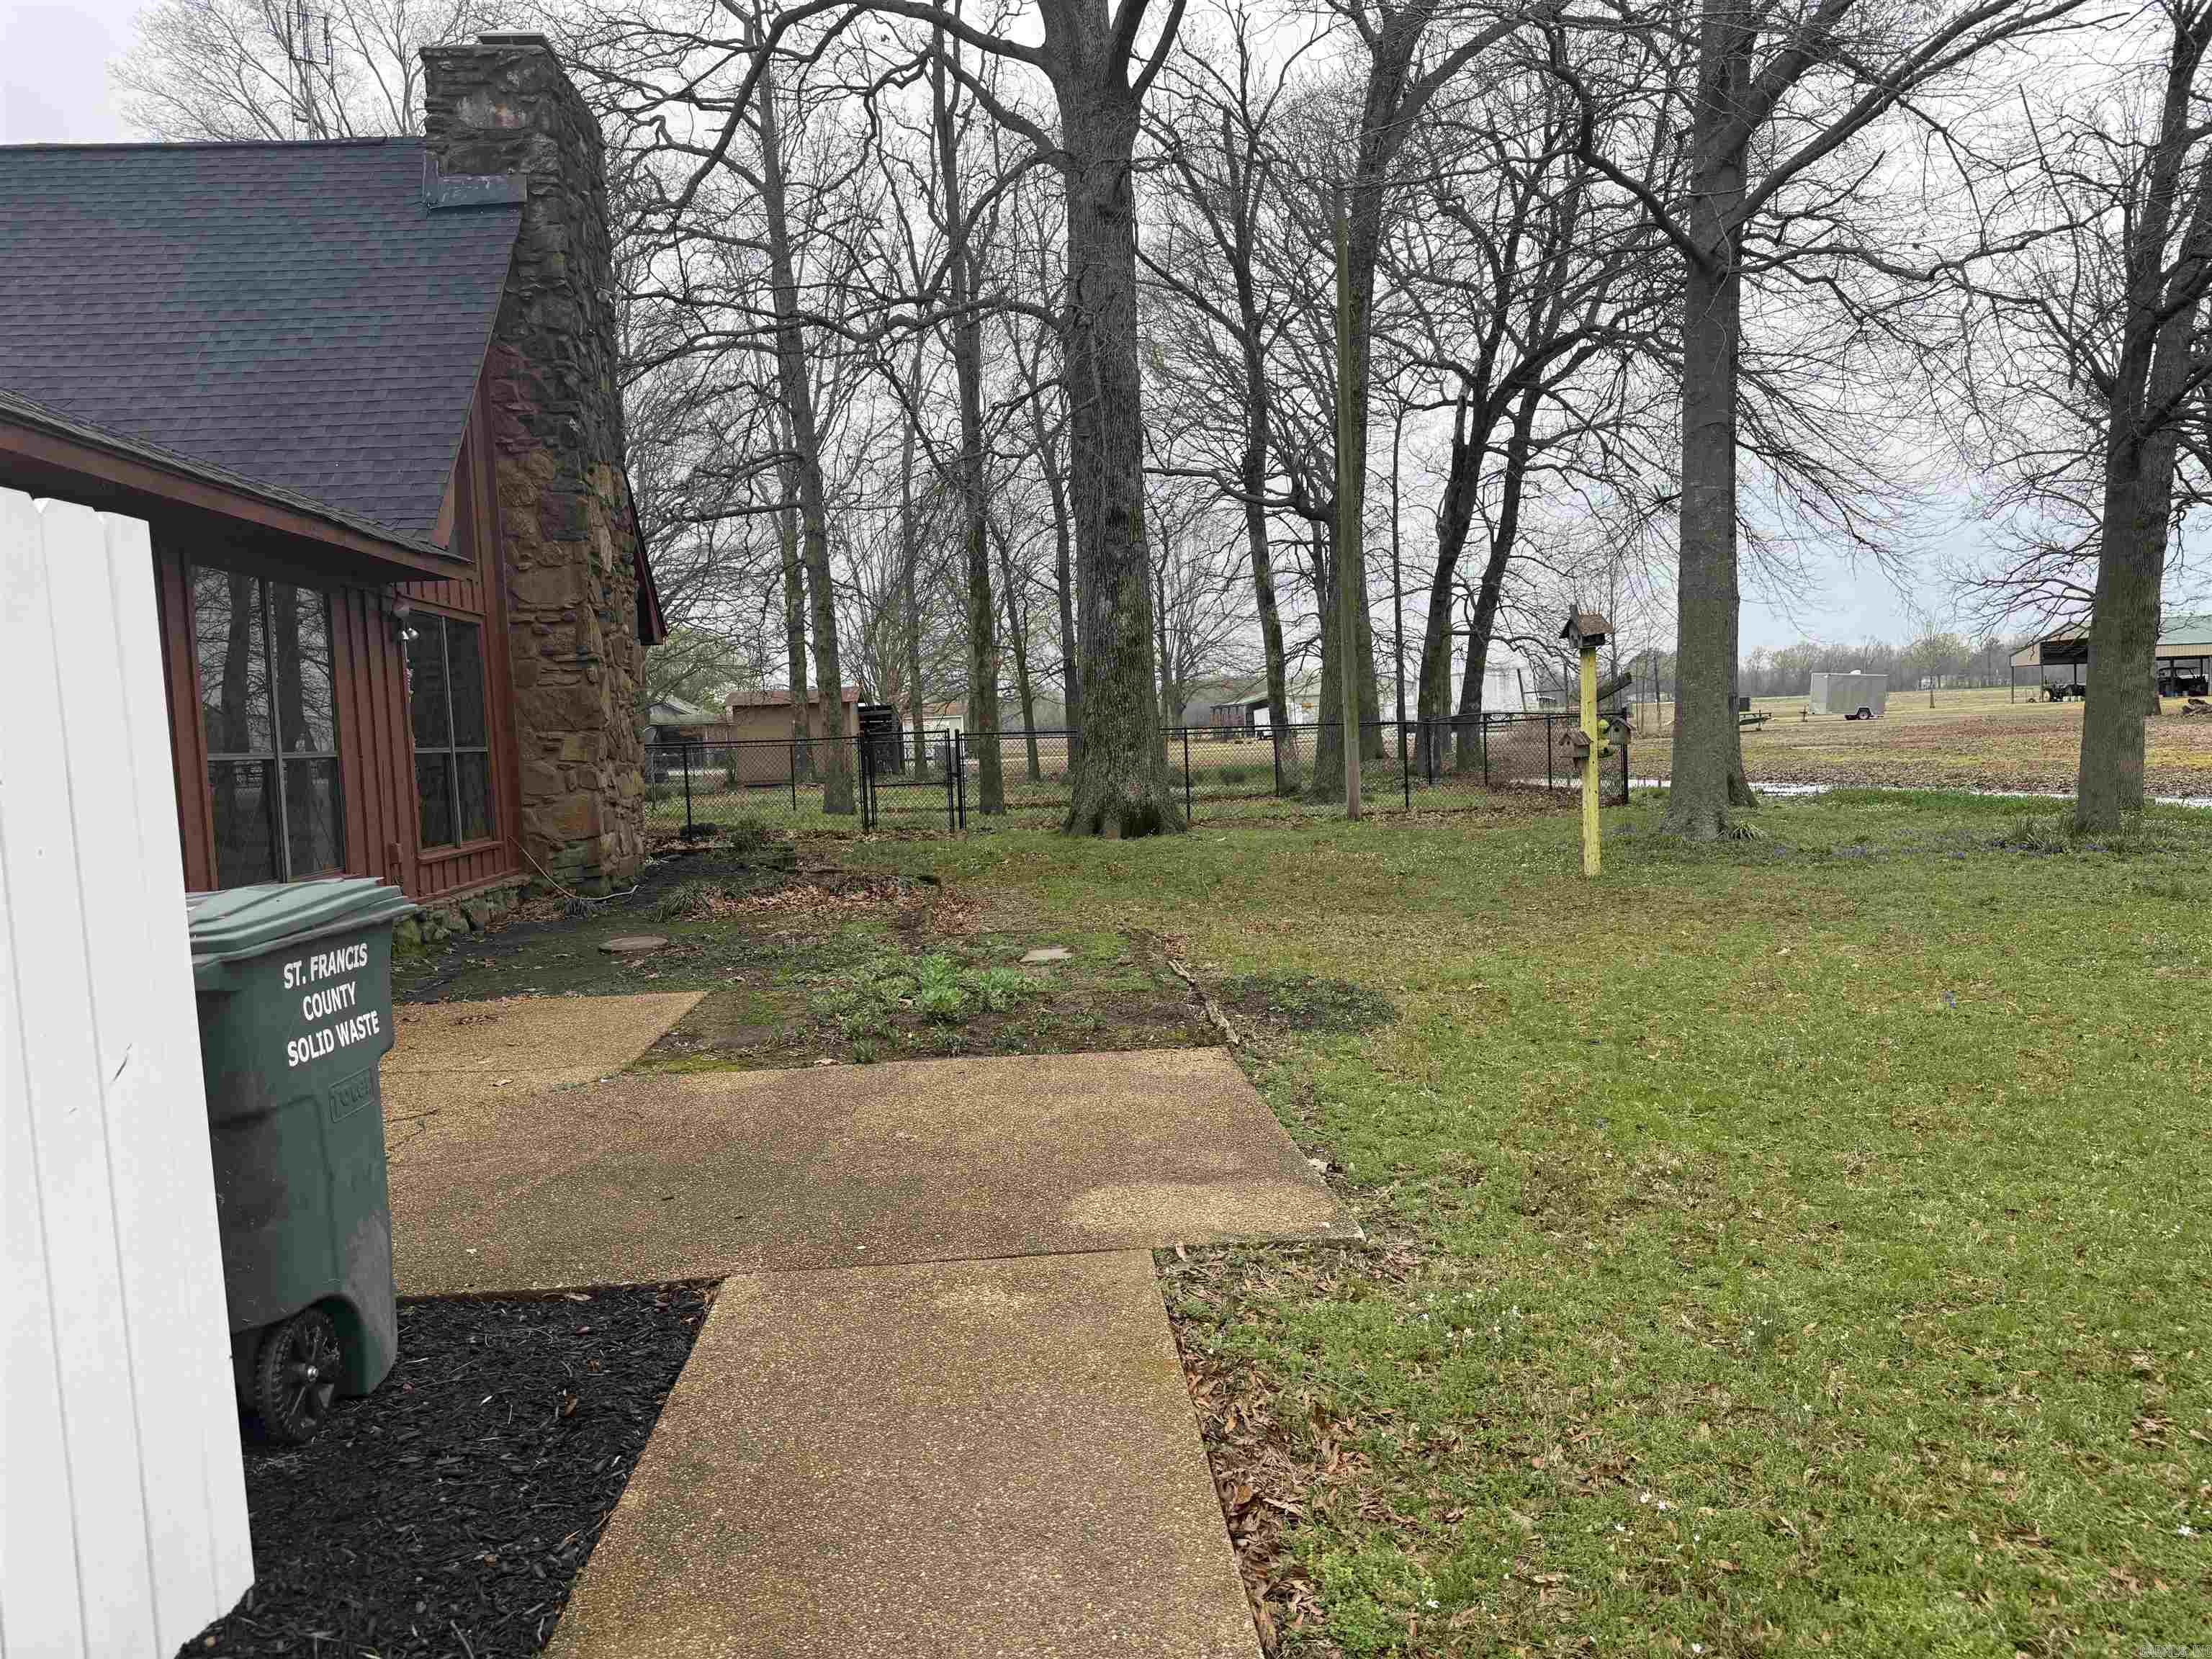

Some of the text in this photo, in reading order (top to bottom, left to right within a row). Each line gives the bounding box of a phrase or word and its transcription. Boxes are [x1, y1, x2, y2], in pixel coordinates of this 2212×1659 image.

[284, 943, 368, 989] ST. FRANCIS
[303, 981, 356, 1020] COUNTY
[287, 1010, 380, 1066] SOLID WASTE
